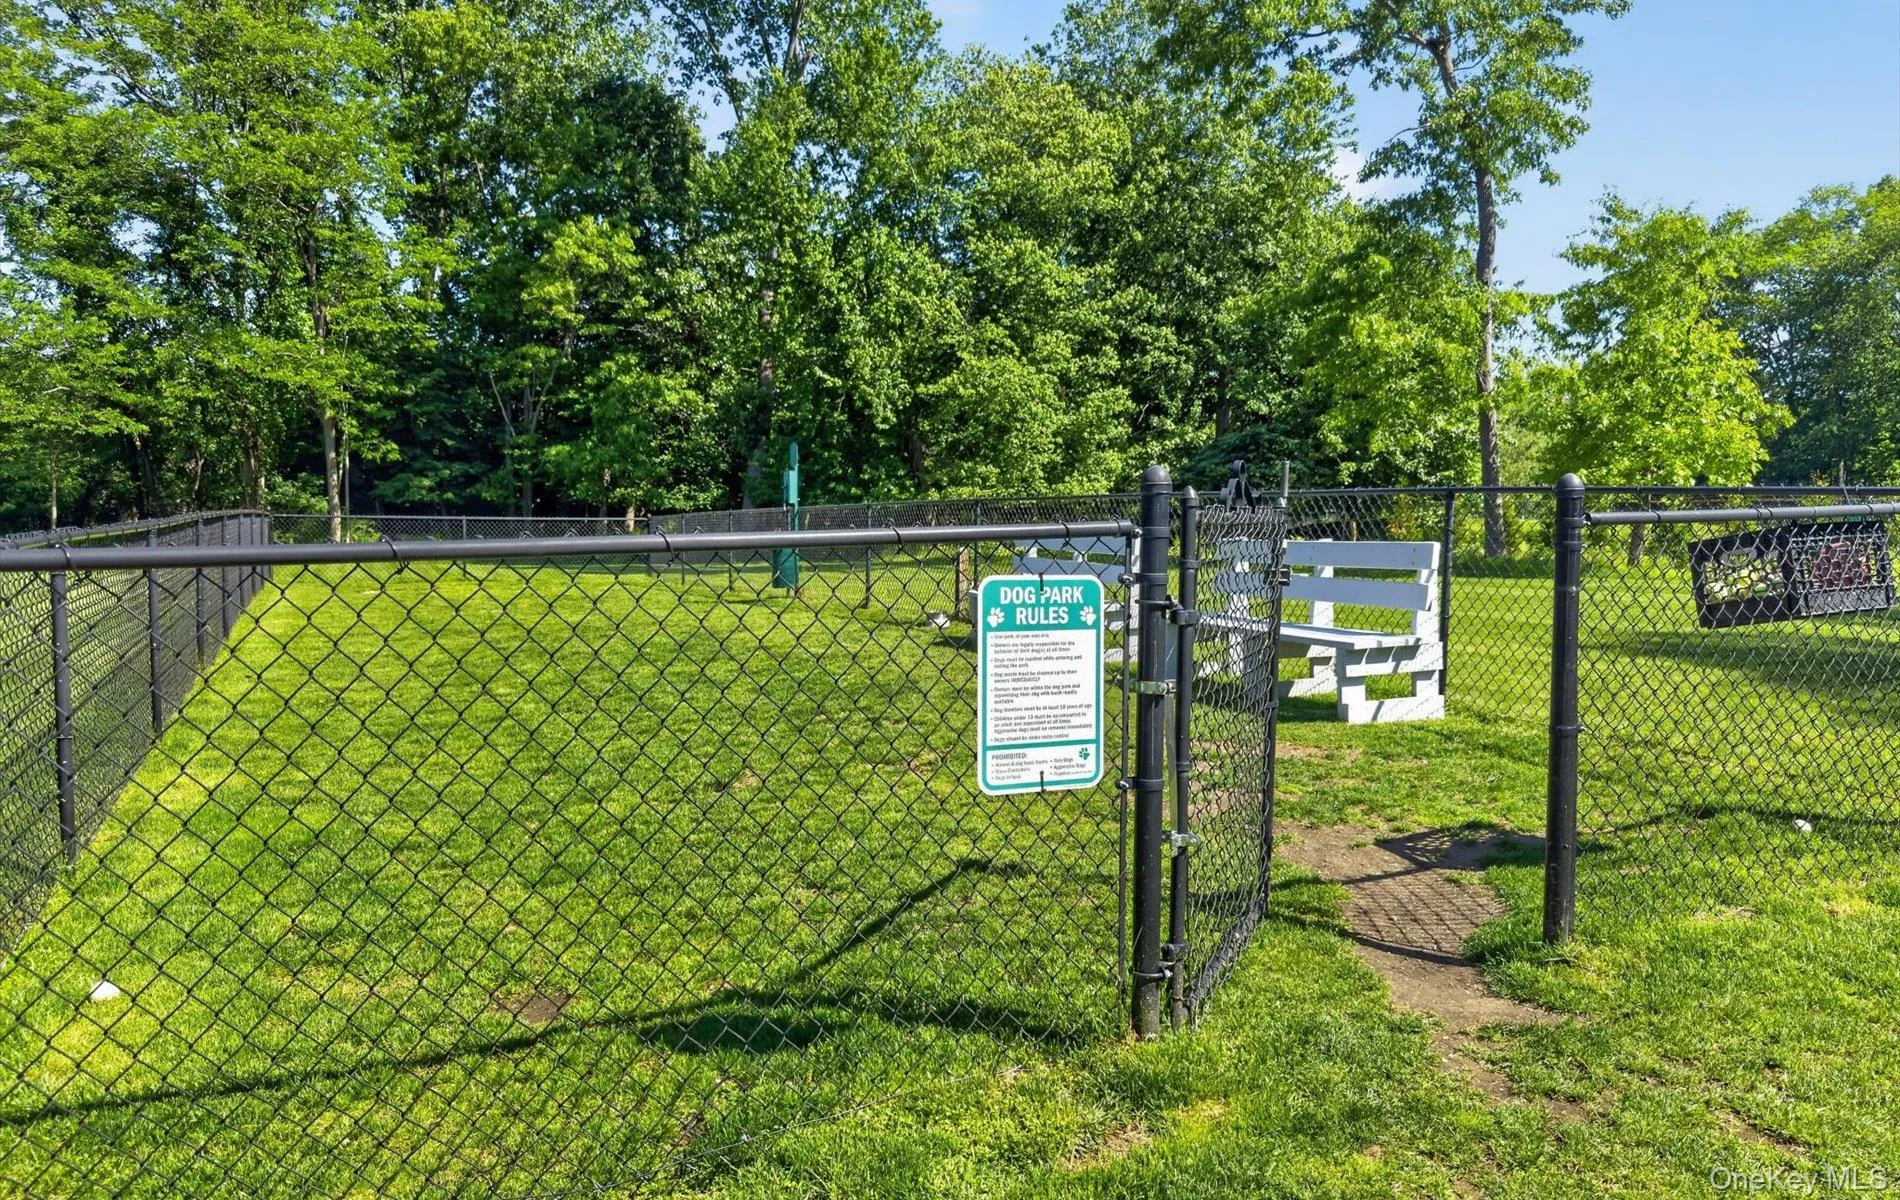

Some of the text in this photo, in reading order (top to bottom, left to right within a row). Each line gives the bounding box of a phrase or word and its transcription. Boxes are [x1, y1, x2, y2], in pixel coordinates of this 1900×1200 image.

[1000, 586, 1084, 604] DOG PARK
[1016, 606, 1069, 625] RULES
[991, 752, 1028, 760] PROHIBITED:
